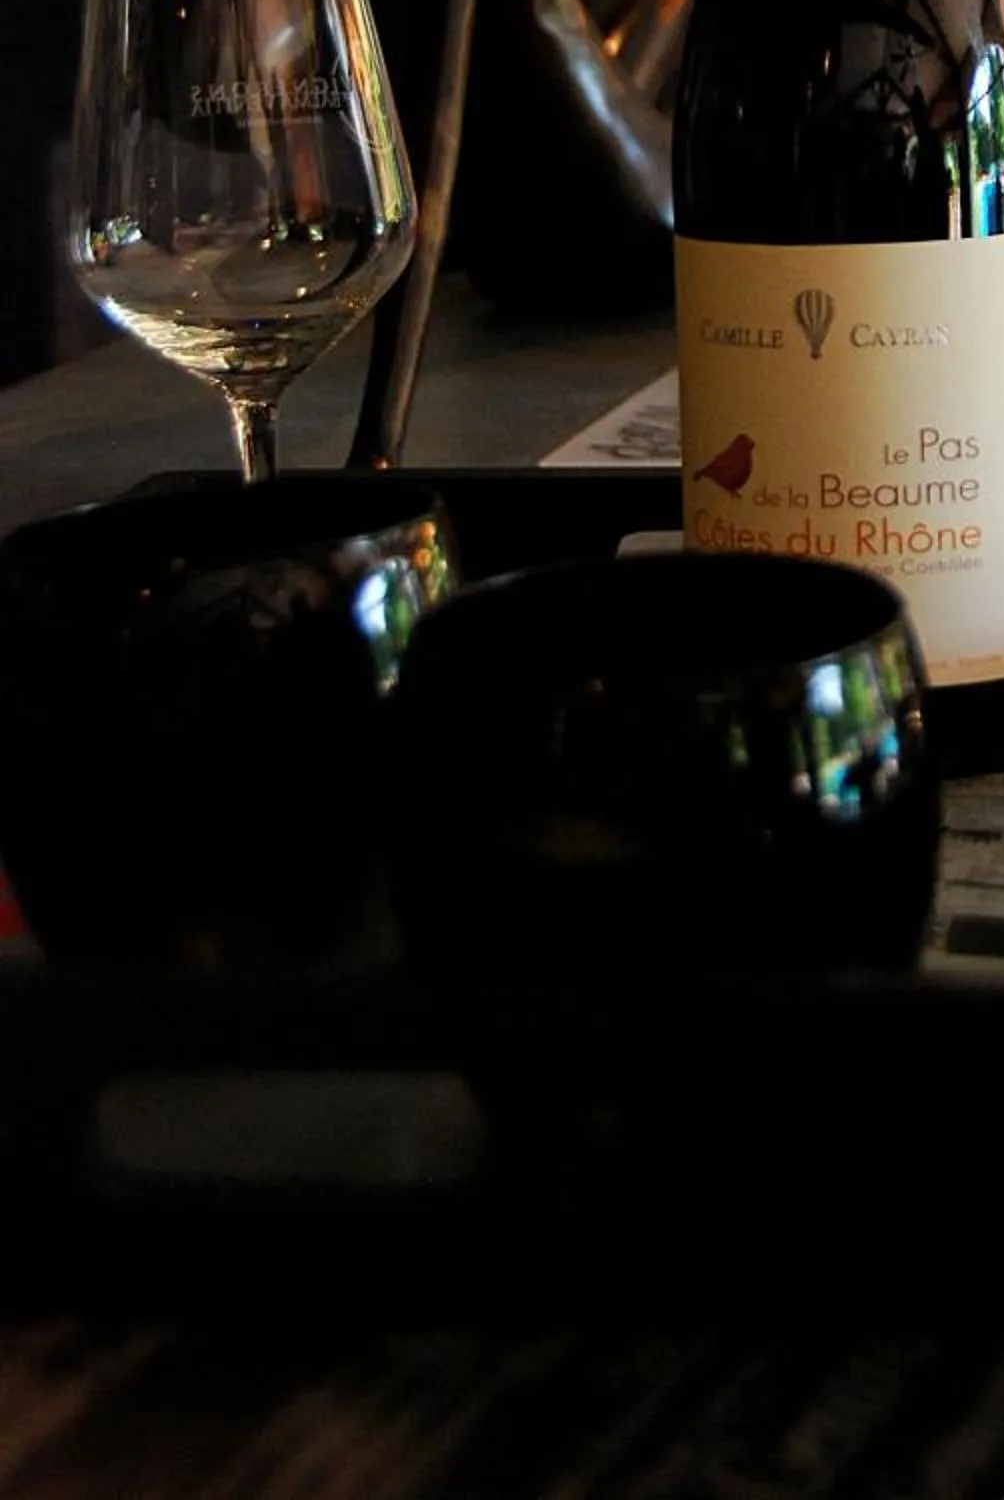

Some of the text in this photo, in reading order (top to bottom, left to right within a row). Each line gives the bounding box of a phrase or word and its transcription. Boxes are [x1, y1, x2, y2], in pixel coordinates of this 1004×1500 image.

[701, 318, 951, 349] CAMILLE CAYRAN
[884, 427, 980, 465] Le Pas
[753, 473, 980, 510] de la Beaume
[695, 508, 982, 558] Côtes du Rhône
